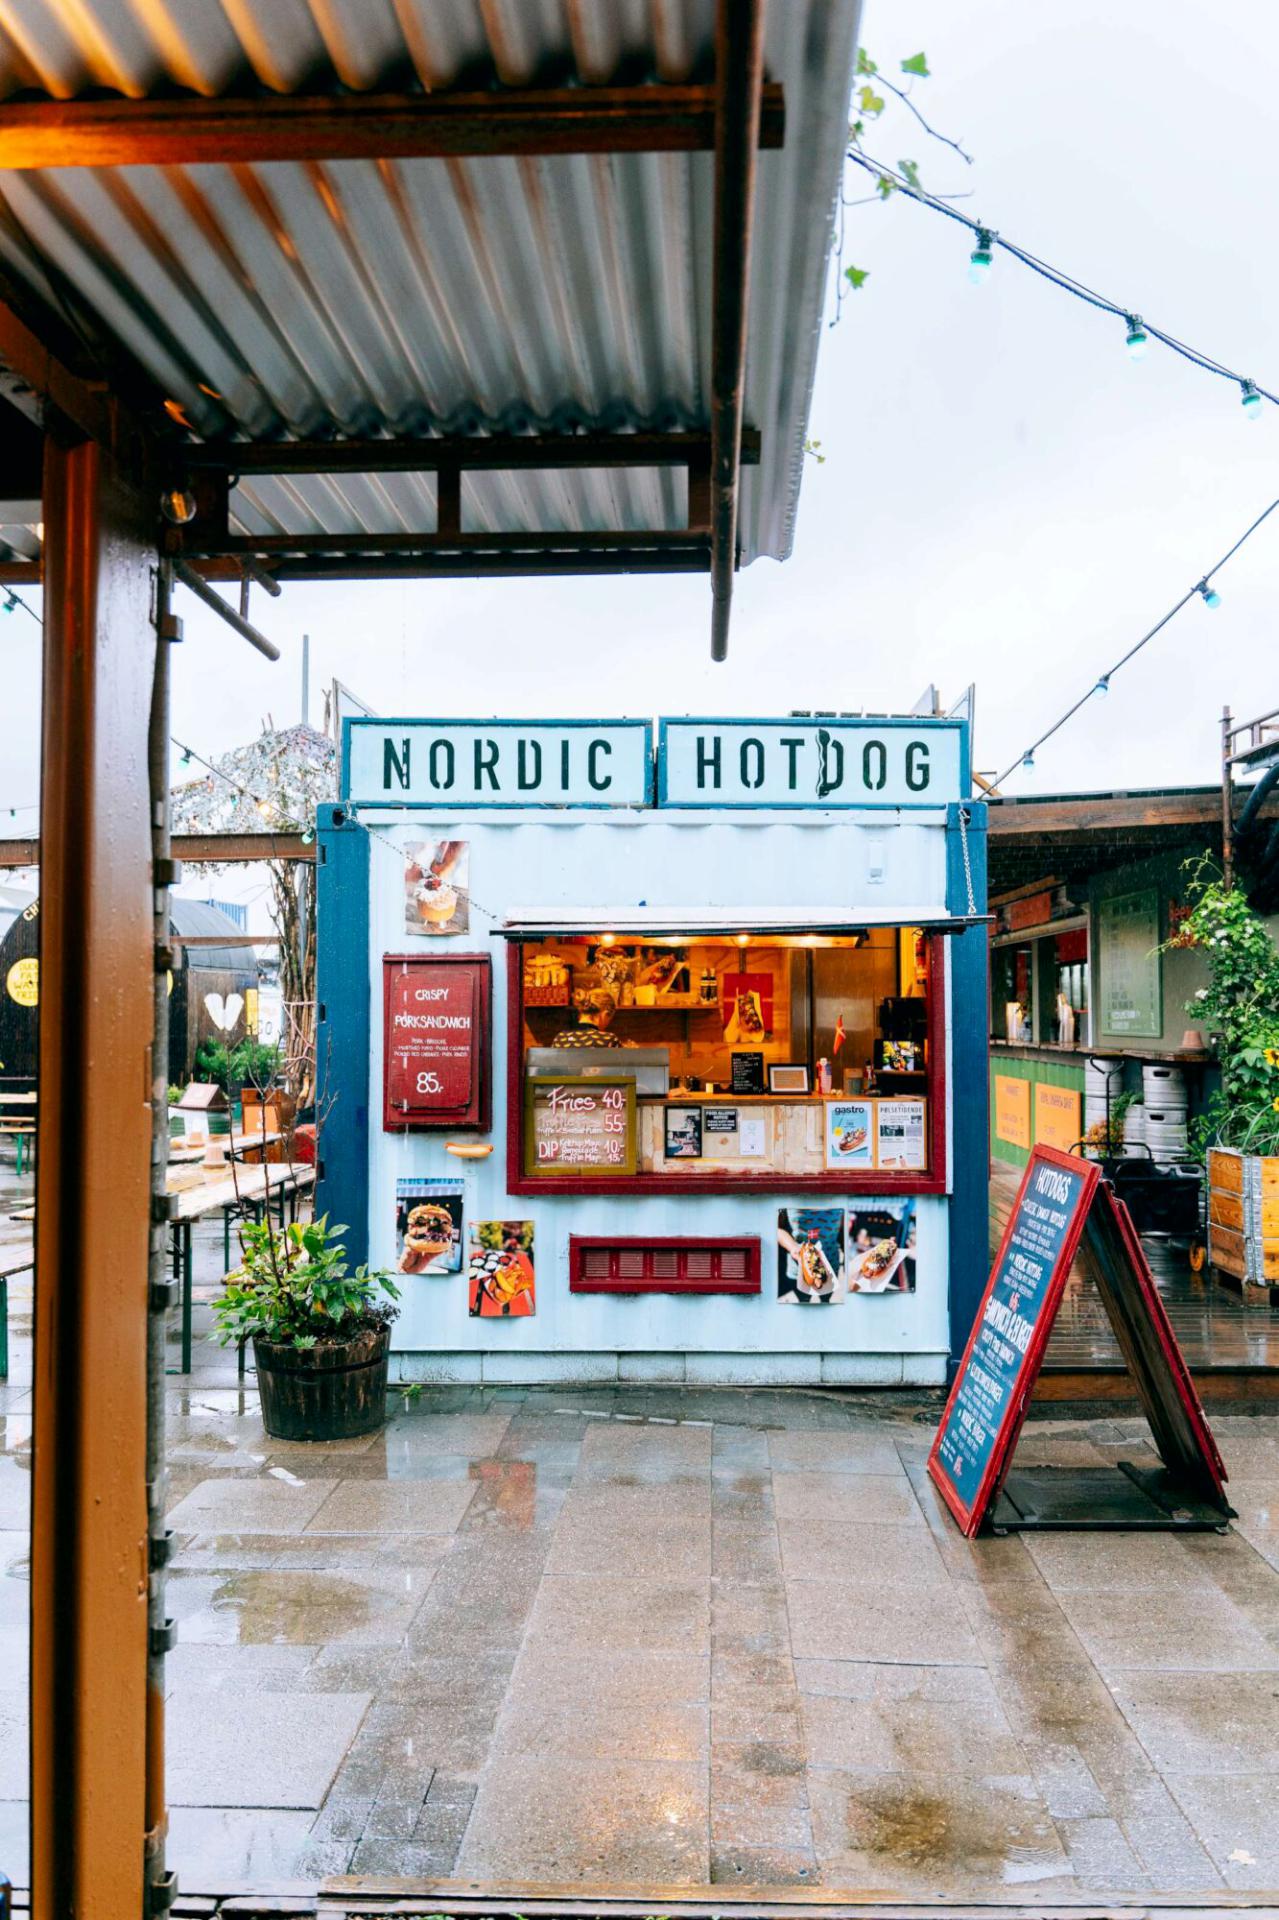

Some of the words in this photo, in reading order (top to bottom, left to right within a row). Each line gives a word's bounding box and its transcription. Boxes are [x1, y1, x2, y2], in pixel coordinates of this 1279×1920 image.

[383, 737, 613, 791] NORDIC
[697, 729, 931, 799] HOTDOG
[415, 988, 449, 1001] CRISPY
[546, 1085, 597, 1115] Fries
[834, 1105, 865, 1116] gastro
[538, 1140, 559, 1158] DIP
[1035, 1166, 1072, 1205] HOTDOGS
